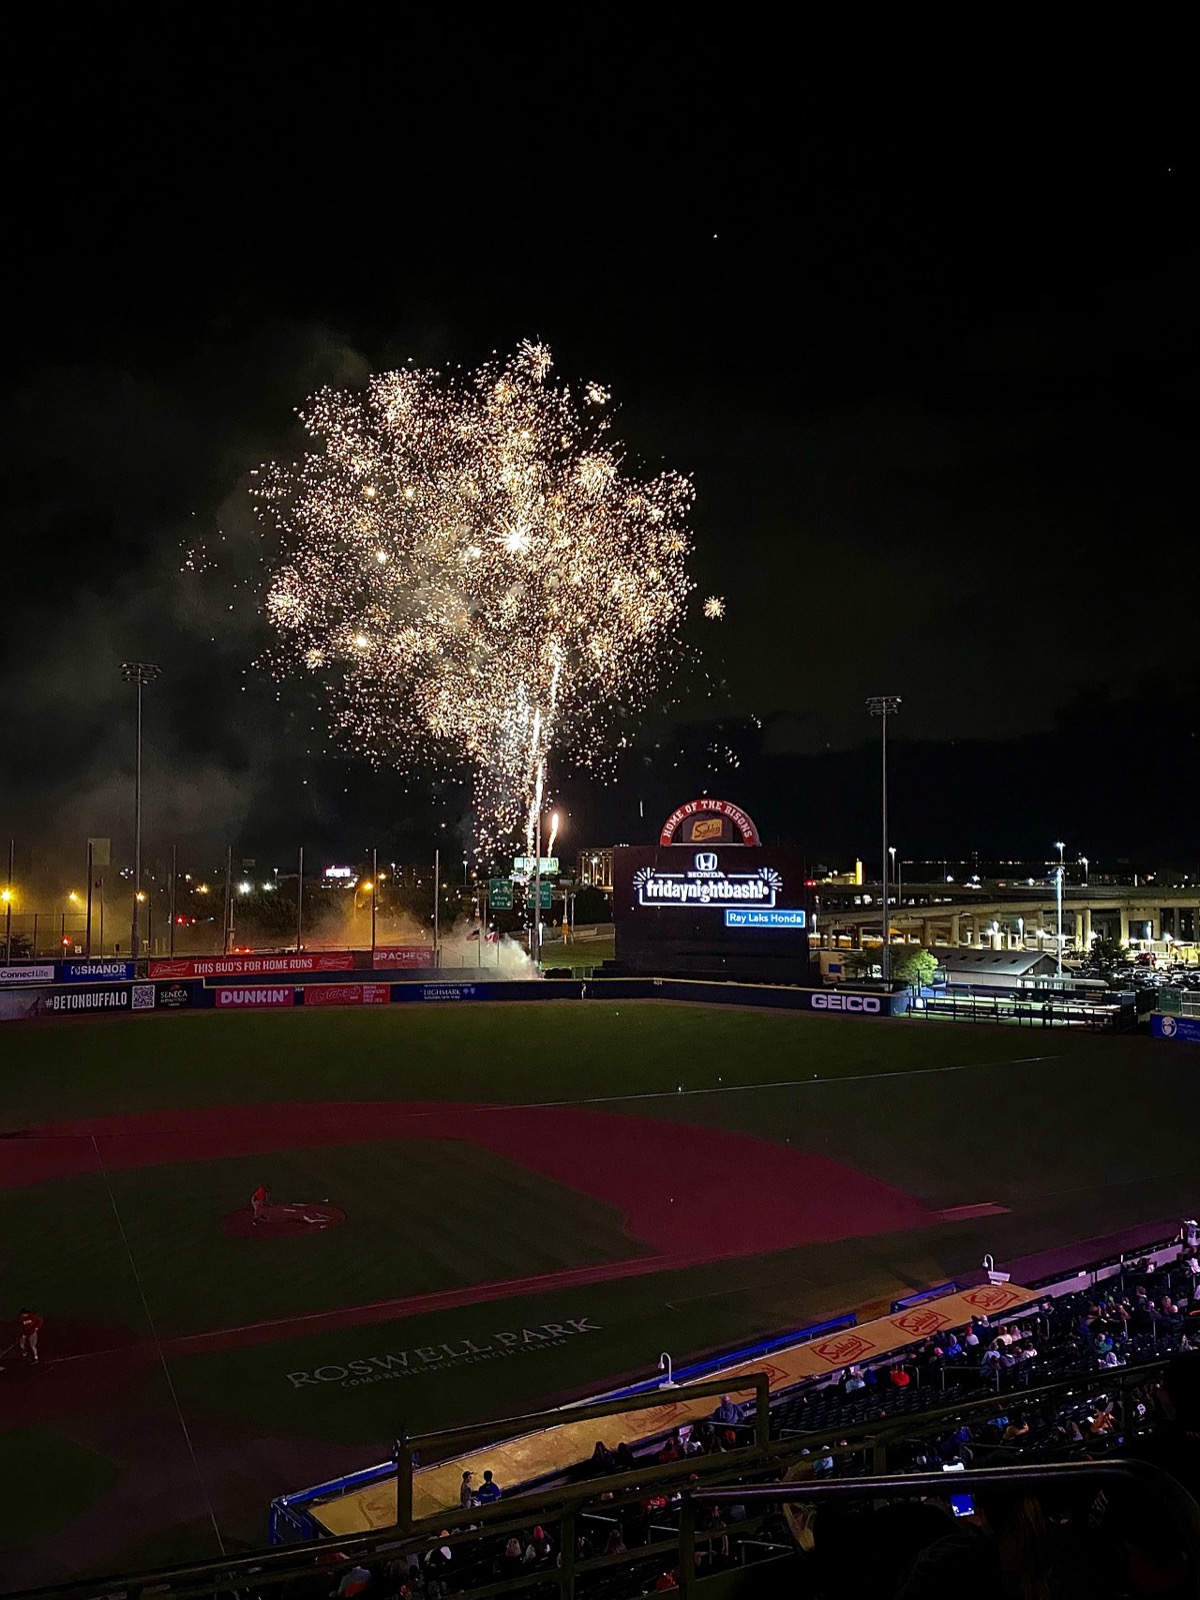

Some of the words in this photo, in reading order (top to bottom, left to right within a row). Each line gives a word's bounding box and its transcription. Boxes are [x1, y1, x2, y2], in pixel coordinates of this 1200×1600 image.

[663, 810, 684, 838] HOME
[685, 802, 698, 813] OF
[700, 800, 723, 811] THE
[724, 805, 753, 838] BISONS
[730, 913, 747, 924] Ray
[748, 913, 769, 923] Laks
[770, 913, 802, 923] Honda
[80, 964, 127, 975] SHANOR
[193, 963, 214, 974] THIS
[215, 961, 242, 972] BUD'S
[244, 961, 261, 971] FOR
[263, 960, 288, 970] HOME
[290, 958, 313, 969] RUNS
[45, 991, 128, 1010] #BETONBUFFALO
[160, 989, 188, 998] SENECA
[220, 989, 289, 1004] DUNKIN'
[811, 993, 880, 1013] GEICO
[285, 1338, 492, 1389] ROSWELL
[494, 1317, 603, 1346] PARK
